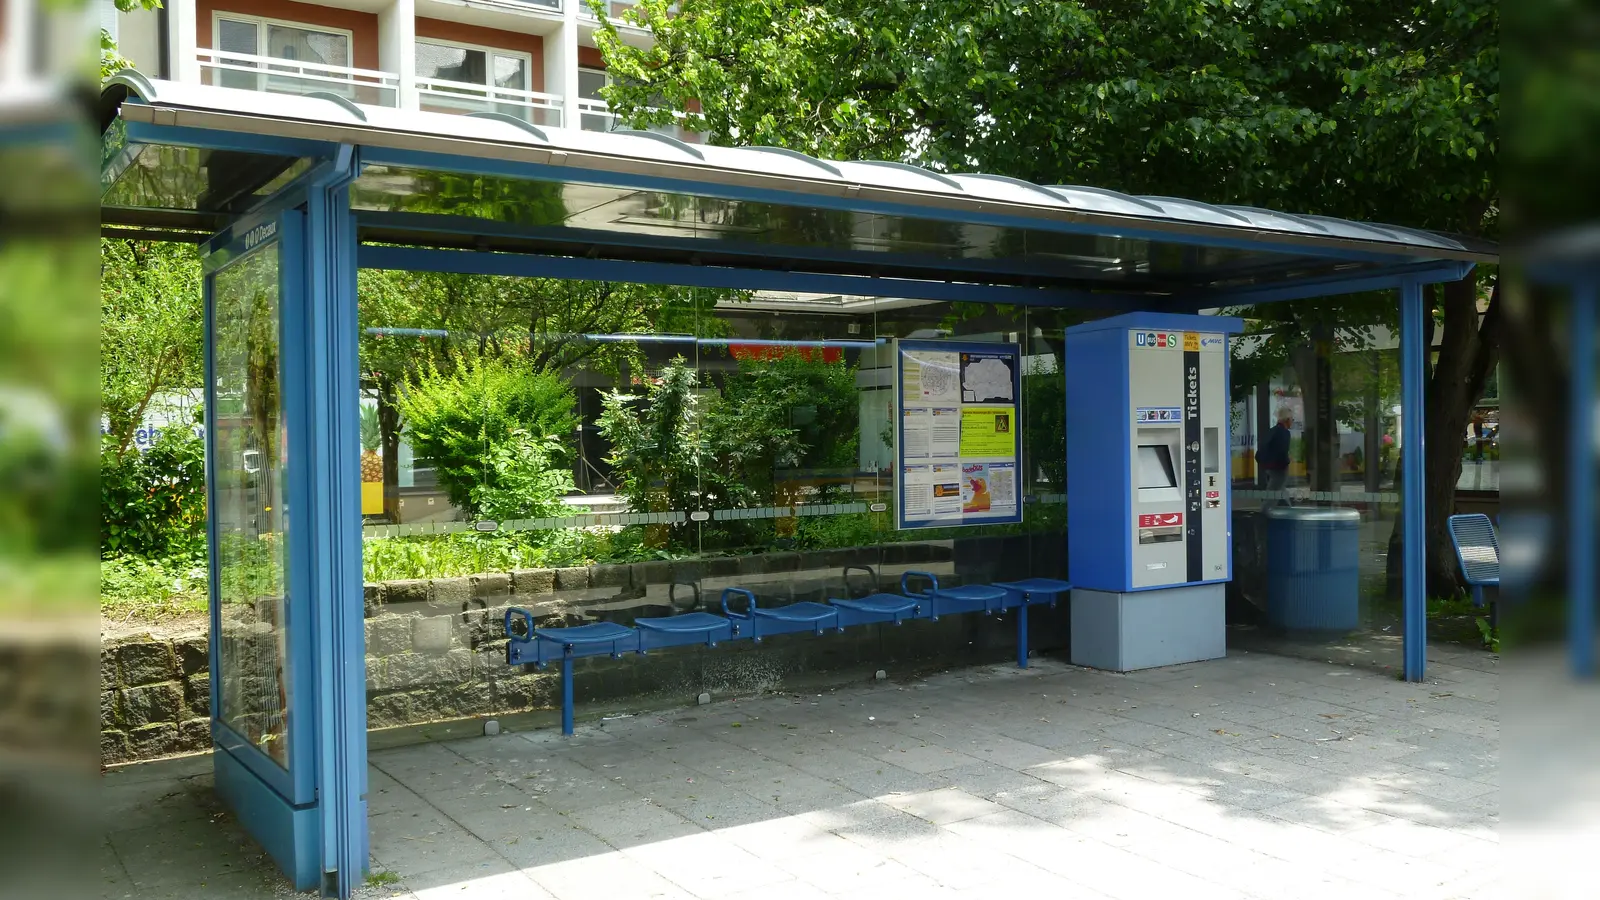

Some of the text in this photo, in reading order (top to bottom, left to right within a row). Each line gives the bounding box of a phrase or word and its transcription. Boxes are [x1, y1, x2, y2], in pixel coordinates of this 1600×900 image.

[1138, 335, 1145, 345] U
[1168, 335, 1175, 347] S
[1187, 366, 1198, 420] Tickets
